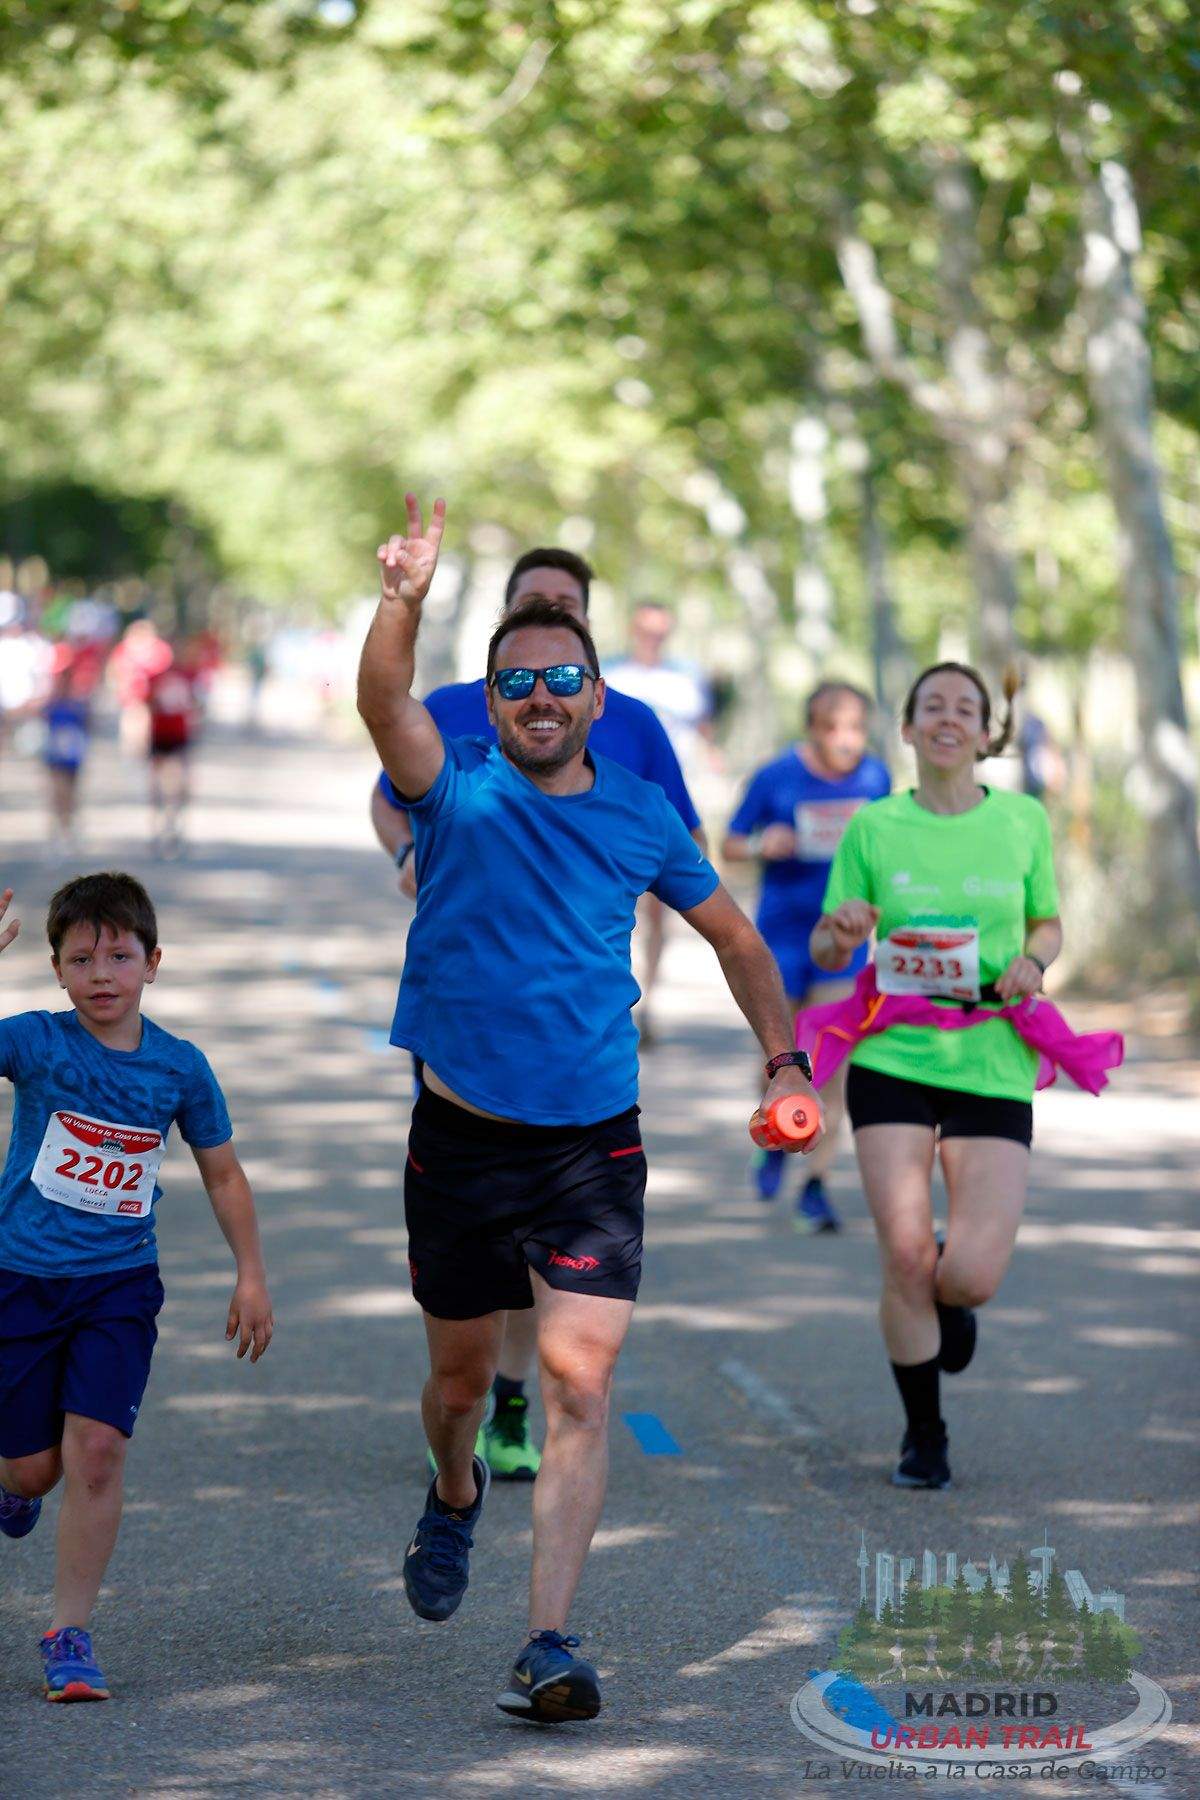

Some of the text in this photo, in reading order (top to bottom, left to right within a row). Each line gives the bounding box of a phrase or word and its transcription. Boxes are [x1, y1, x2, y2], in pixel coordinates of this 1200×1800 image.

[891, 955, 963, 979] 2233
[73, 1120, 97, 1133] Vuelta
[113, 1132, 132, 1142] Casa
[55, 1148, 143, 1191] 2202
